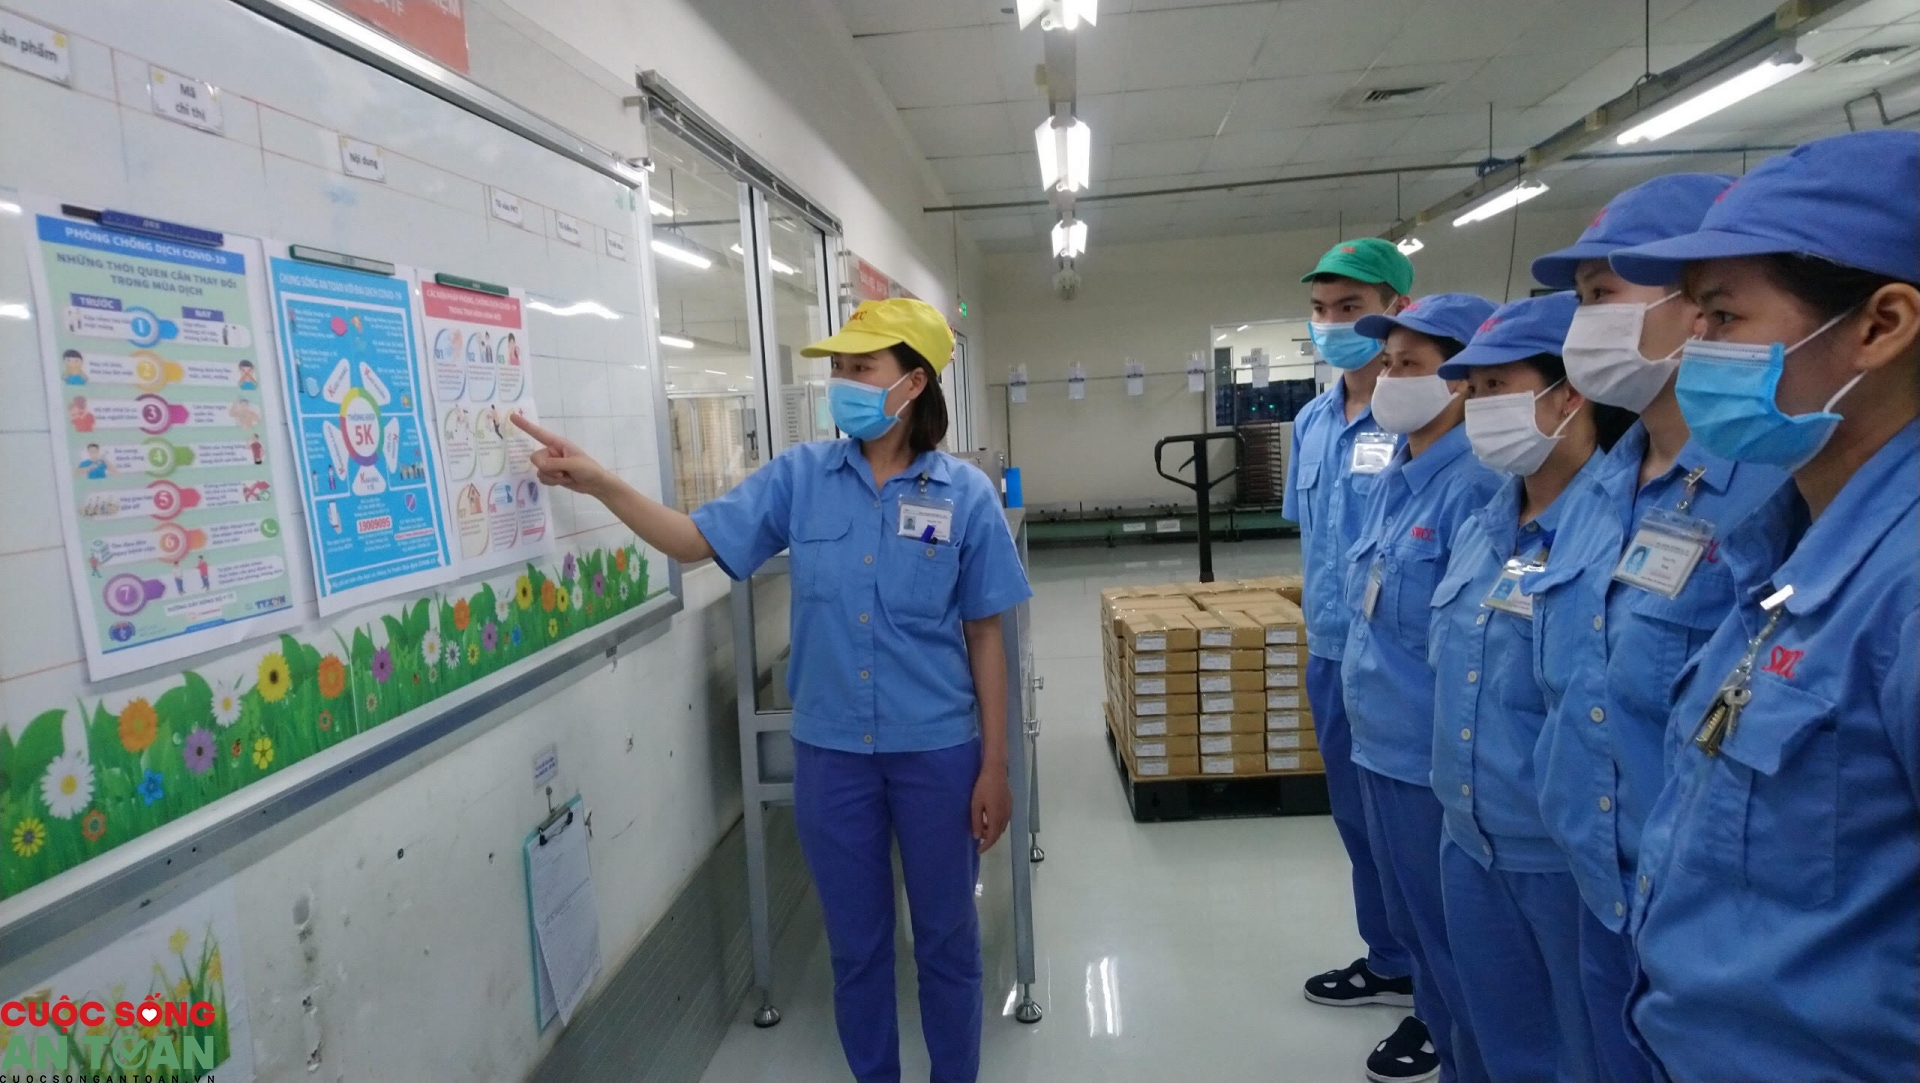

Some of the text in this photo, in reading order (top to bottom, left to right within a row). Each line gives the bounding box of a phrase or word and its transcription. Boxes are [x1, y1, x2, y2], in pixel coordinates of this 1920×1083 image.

[179, 83, 196, 99] Mã
[65, 227, 227, 265] PHÒNG CHỐNG DỊCH COVID-19
[57, 252, 104, 269] NHỮNG
[137, 266, 168, 282] QUEN
[193, 273, 218, 287] THAY
[110, 274, 150, 290] TRONG
[178, 284, 203, 298] DỊCH
[137, 319, 144, 334] 1
[435, 348, 444, 360] 01
[142, 363, 151, 377] 2
[147, 407, 157, 421] 3
[355, 423, 375, 446] 5K
[154, 451, 163, 465] 4
[159, 491, 168, 506] 5
[166, 536, 174, 550] 6
[120, 586, 129, 600] 7
